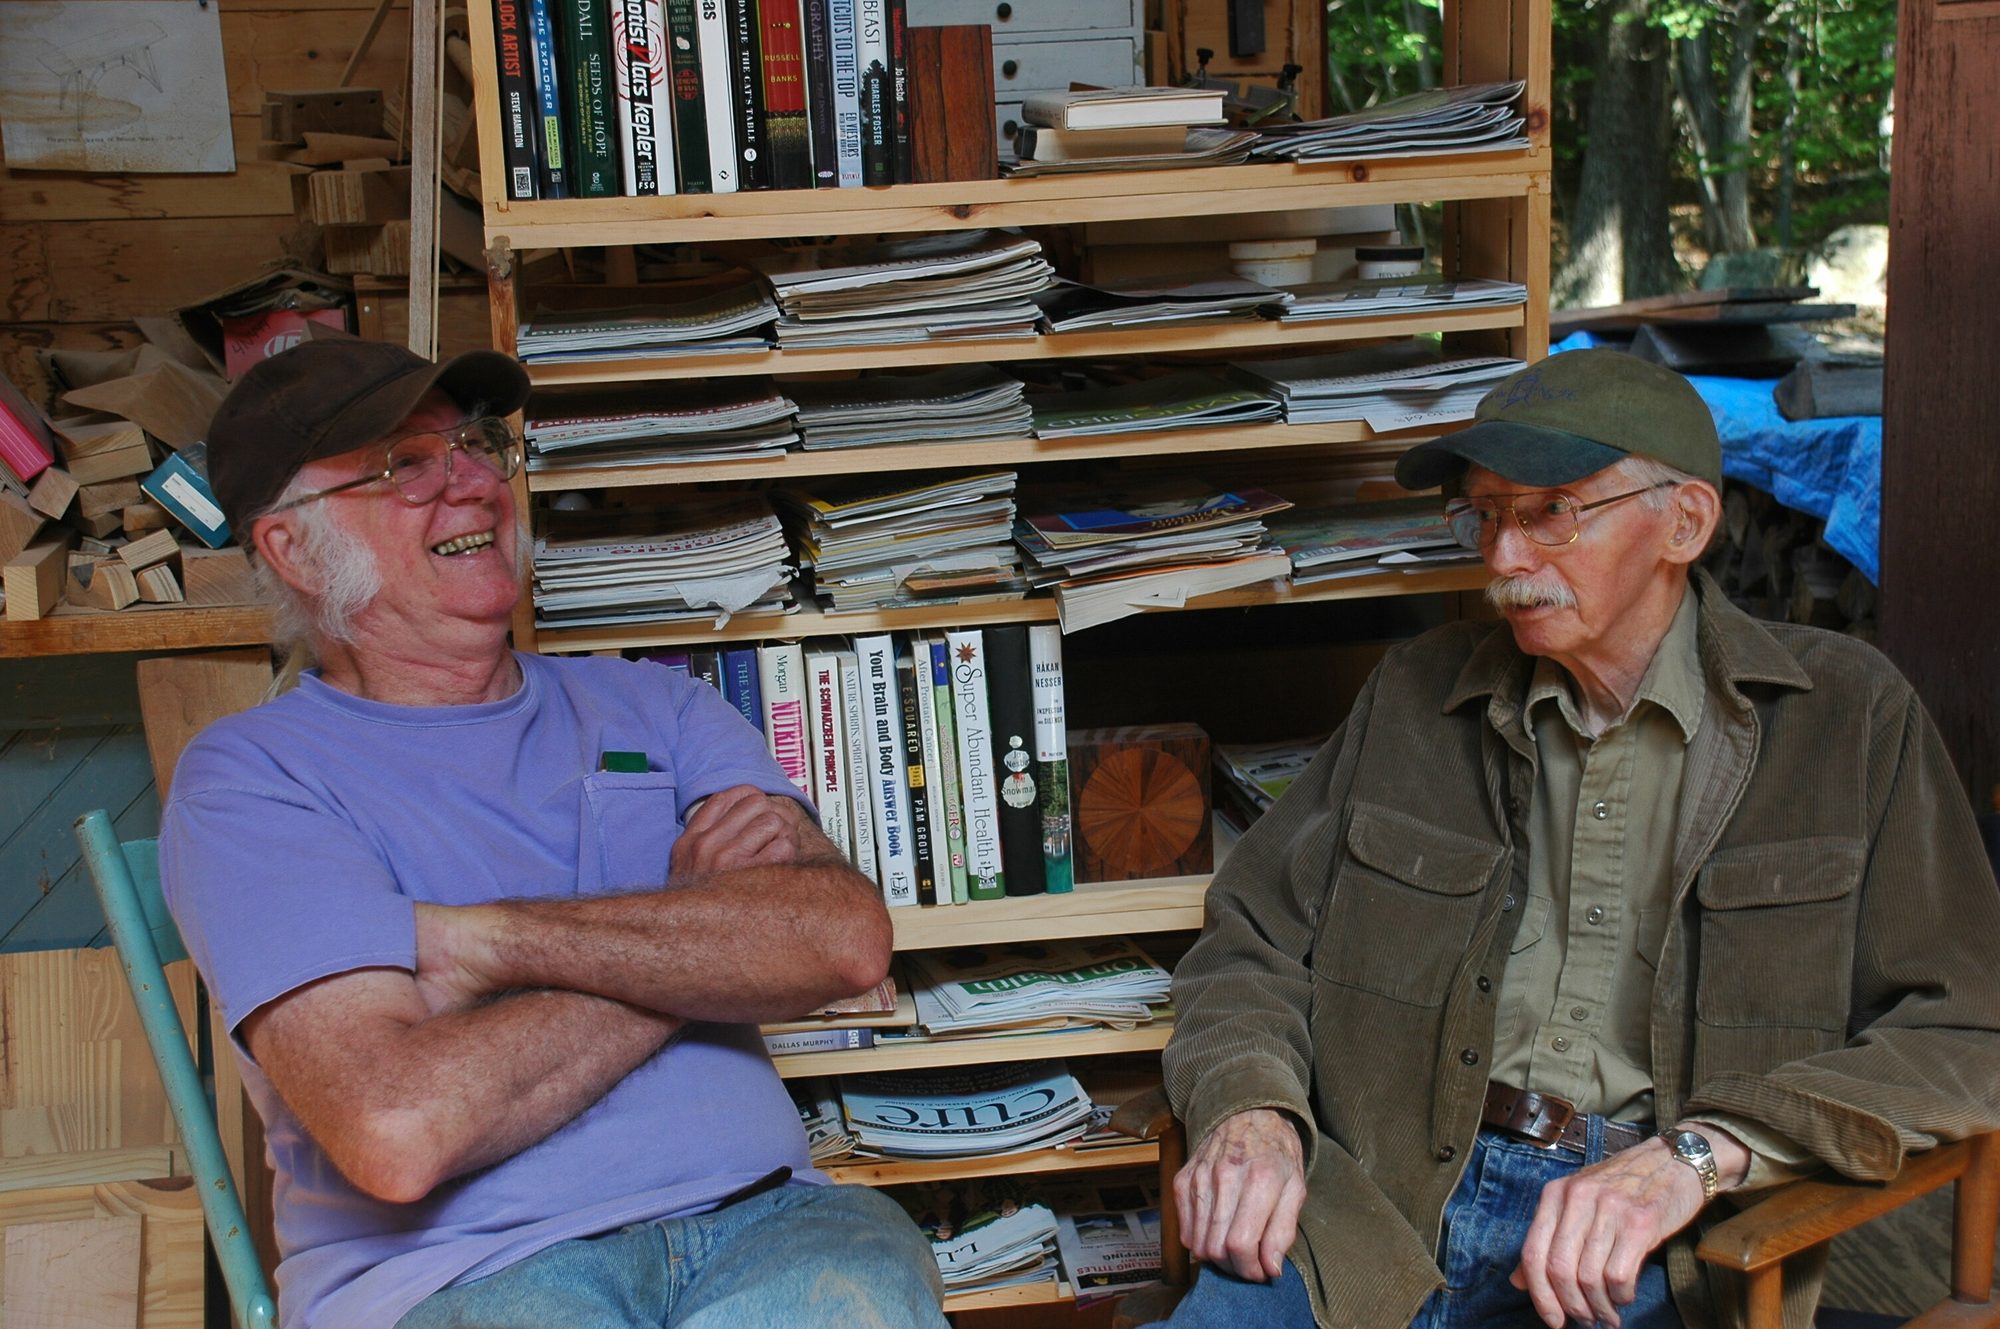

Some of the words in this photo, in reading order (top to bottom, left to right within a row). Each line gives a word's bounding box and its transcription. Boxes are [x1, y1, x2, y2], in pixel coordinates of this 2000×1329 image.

[538, 11, 546, 35] THE
[703, 0, 717, 20] as
[863, 0, 880, 46] BEAST
[810, 1, 824, 62] GRAPHY
[835, 36, 853, 50] TO
[501, 34, 520, 78] ARTIST
[742, 50, 750, 72] THE
[836, 54, 854, 74] THE
[540, 42, 552, 109] EXPLORER
[588, 54, 602, 94] SEEDS
[631, 61, 651, 96] lars
[770, 74, 798, 82] BANKS
[896, 67, 904, 76] Jo
[510, 92, 521, 112] STEVE
[744, 75, 752, 106] CAT'S
[837, 76, 855, 98] TOP
[871, 78, 881, 114] CHARLES
[896, 77, 904, 102] Nesbø
[593, 100, 603, 116] OF
[846, 112, 858, 122] ED
[512, 114, 524, 148] HAMILTON
[595, 121, 606, 158] HOPE
[632, 102, 656, 160] kepler
[746, 110, 754, 142] TABLE
[846, 124, 859, 158] VIESTURS
[873, 116, 882, 145] FOSTER
[738, 661, 749, 686] THE
[775, 654, 788, 693] Morgan
[818, 670, 830, 686] THE
[870, 650, 884, 678] Your
[917, 658, 928, 683] After
[1036, 661, 1059, 673] HÅKAN
[846, 670, 858, 704] NATURE
[955, 664, 983, 720] Super
[1035, 676, 1062, 688] NESSER
[872, 682, 889, 714] Brain
[920, 685, 932, 724] Prostate
[821, 688, 834, 748] SCHWARZBEIN
[878, 720, 892, 743] and
[772, 700, 807, 779] NUTRITION
[851, 739, 862, 764] SPIRIT
[925, 727, 936, 763] Cancer
[824, 750, 838, 792] PRINCIPLE
[879, 746, 895, 776] Body
[967, 727, 989, 802] Abundant
[882, 780, 899, 822] Answer
[914, 800, 927, 822] PAM
[858, 812, 870, 844] GHOSTS
[887, 826, 903, 857] Book
[973, 810, 994, 858] Health
[916, 827, 930, 861] GROUT
[974, 966, 1084, 992] Health
[1090, 958, 1138, 977] On
[772, 1042, 801, 1050] DALLAS
[875, 1088, 1056, 1129] cure
[1076, 1265, 1113, 1274] TITLES
[1102, 1251, 1160, 1260] SHIPPING
[1116, 1261, 1161, 1269] SELLING
